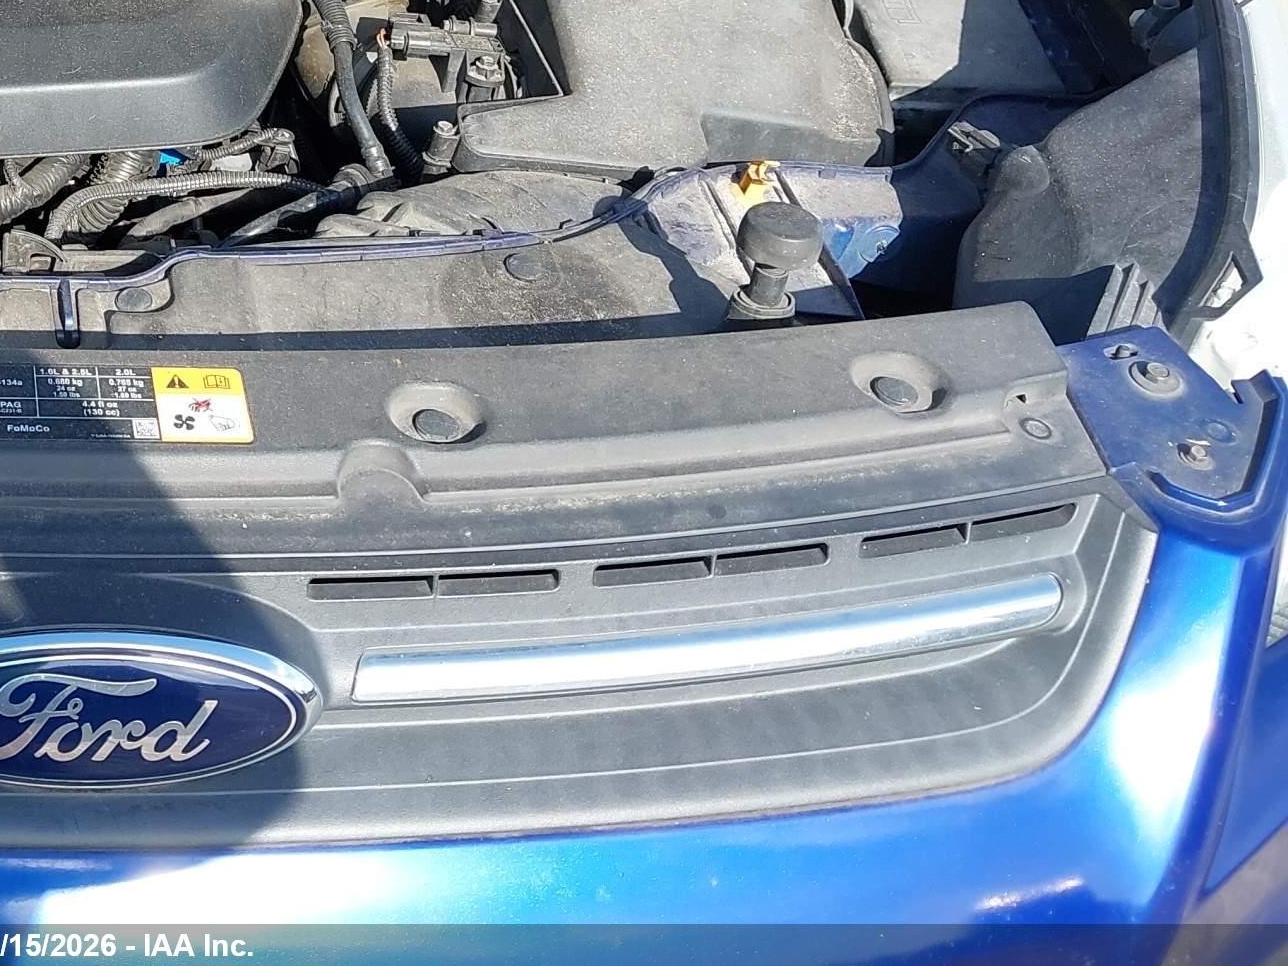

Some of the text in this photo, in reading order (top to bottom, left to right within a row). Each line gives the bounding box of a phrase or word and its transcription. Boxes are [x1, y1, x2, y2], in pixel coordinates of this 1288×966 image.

[72, 378, 83, 387] kg
[133, 379, 144, 388] kg
[7, 424, 51, 432] FoMoCo
